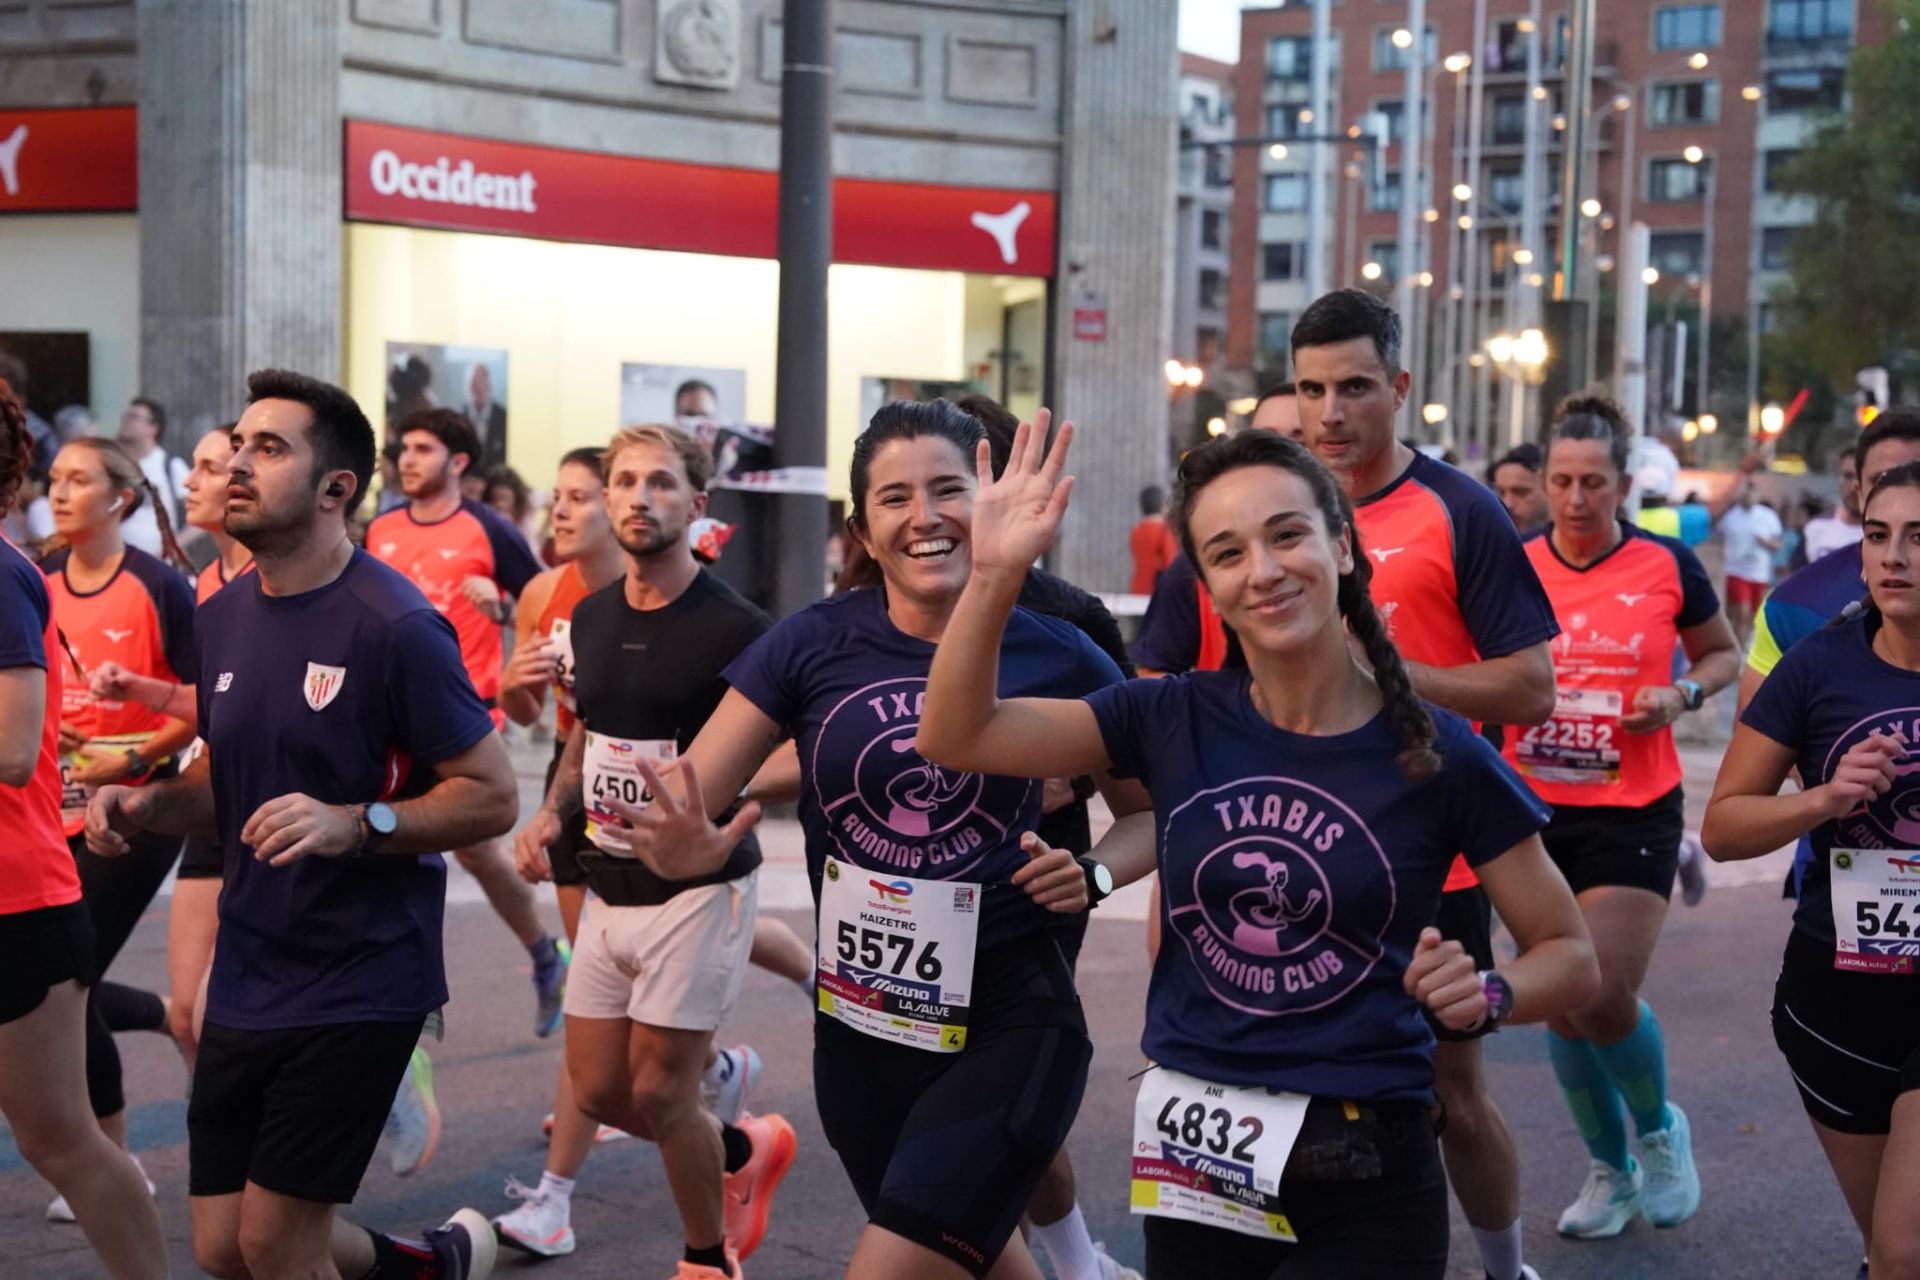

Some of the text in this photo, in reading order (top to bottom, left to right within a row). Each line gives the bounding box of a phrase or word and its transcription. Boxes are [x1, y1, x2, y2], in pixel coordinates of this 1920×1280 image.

[370, 149, 538, 213] Occident
[841, 812, 983, 869] RUNNING CLUB
[1214, 794, 1344, 852] TXABIS
[1880, 888, 1920, 897] MIREN
[860, 912, 917, 932] HAIZETRC
[837, 919, 942, 982] 5576
[1192, 923, 1344, 994] RUNNING CLUB
[898, 999, 950, 1017] LA SALVE
[948, 1033, 959, 1046] 4
[1204, 1085, 1225, 1099] ANE
[1157, 1096, 1264, 1164] 4832
[942, 1232, 984, 1264] WONG
